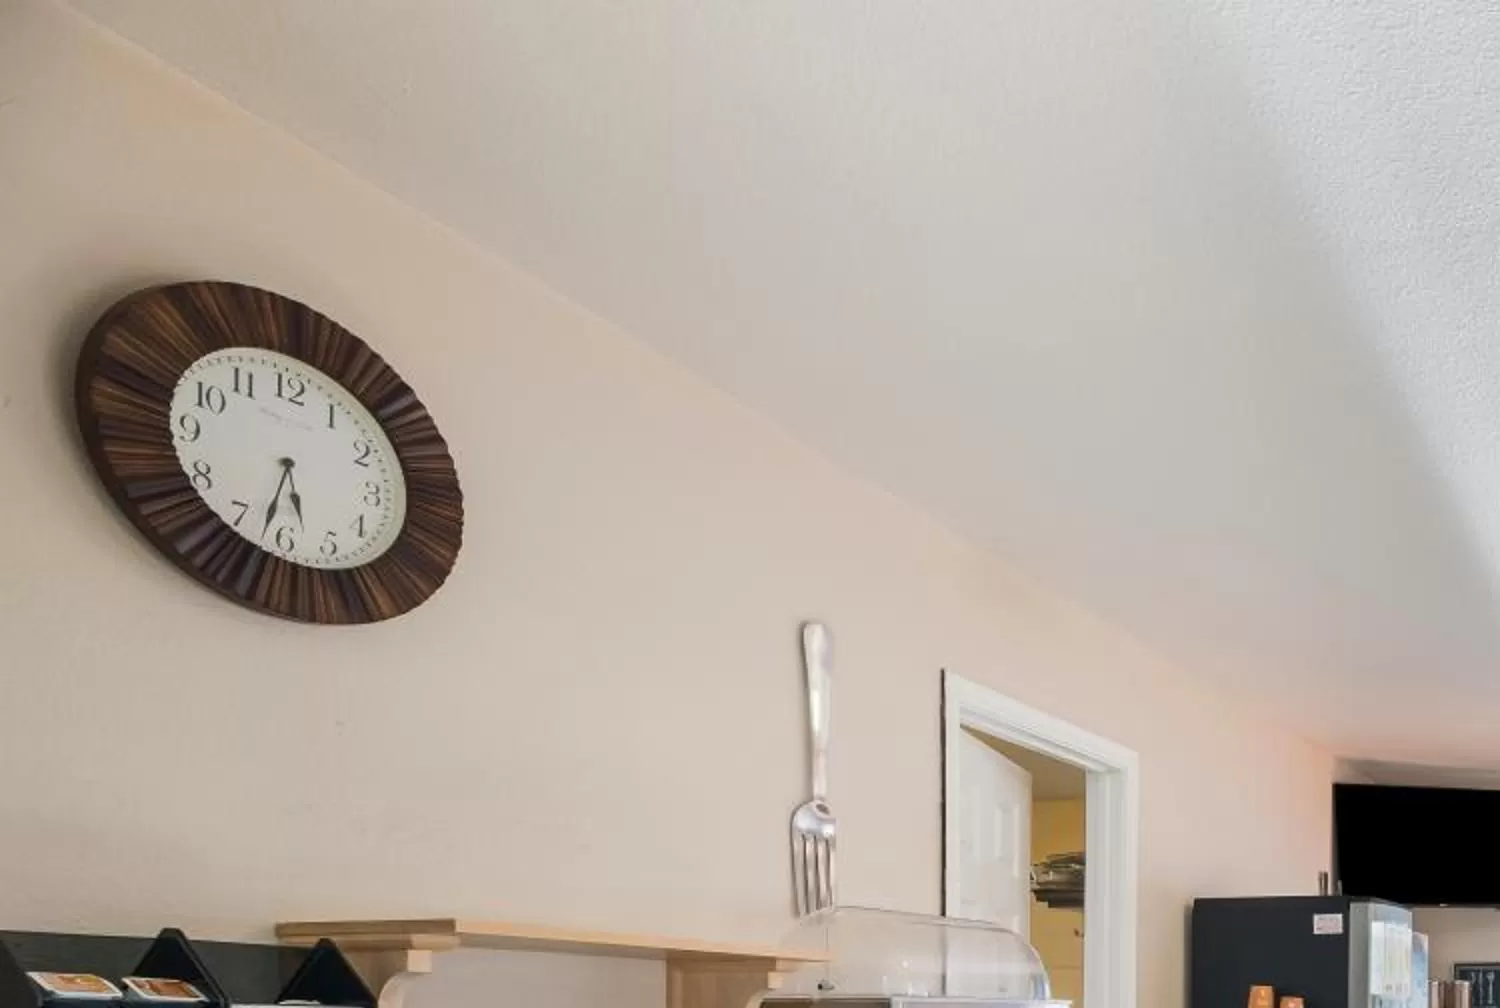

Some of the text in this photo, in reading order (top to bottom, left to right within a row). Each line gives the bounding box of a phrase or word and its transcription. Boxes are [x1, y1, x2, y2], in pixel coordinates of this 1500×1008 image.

[232, 366, 257, 400] 11
[273, 371, 306, 406] 12
[196, 380, 227, 416] 10
[178, 413, 201, 443] 9
[325, 403, 336, 430] 1
[352, 439, 370, 468] 2
[192, 460, 213, 491] 8
[363, 480, 380, 508] 3
[231, 500, 250, 528] 7
[349, 513, 365, 539] 4
[274, 525, 296, 555] 6
[319, 530, 338, 558] 5
